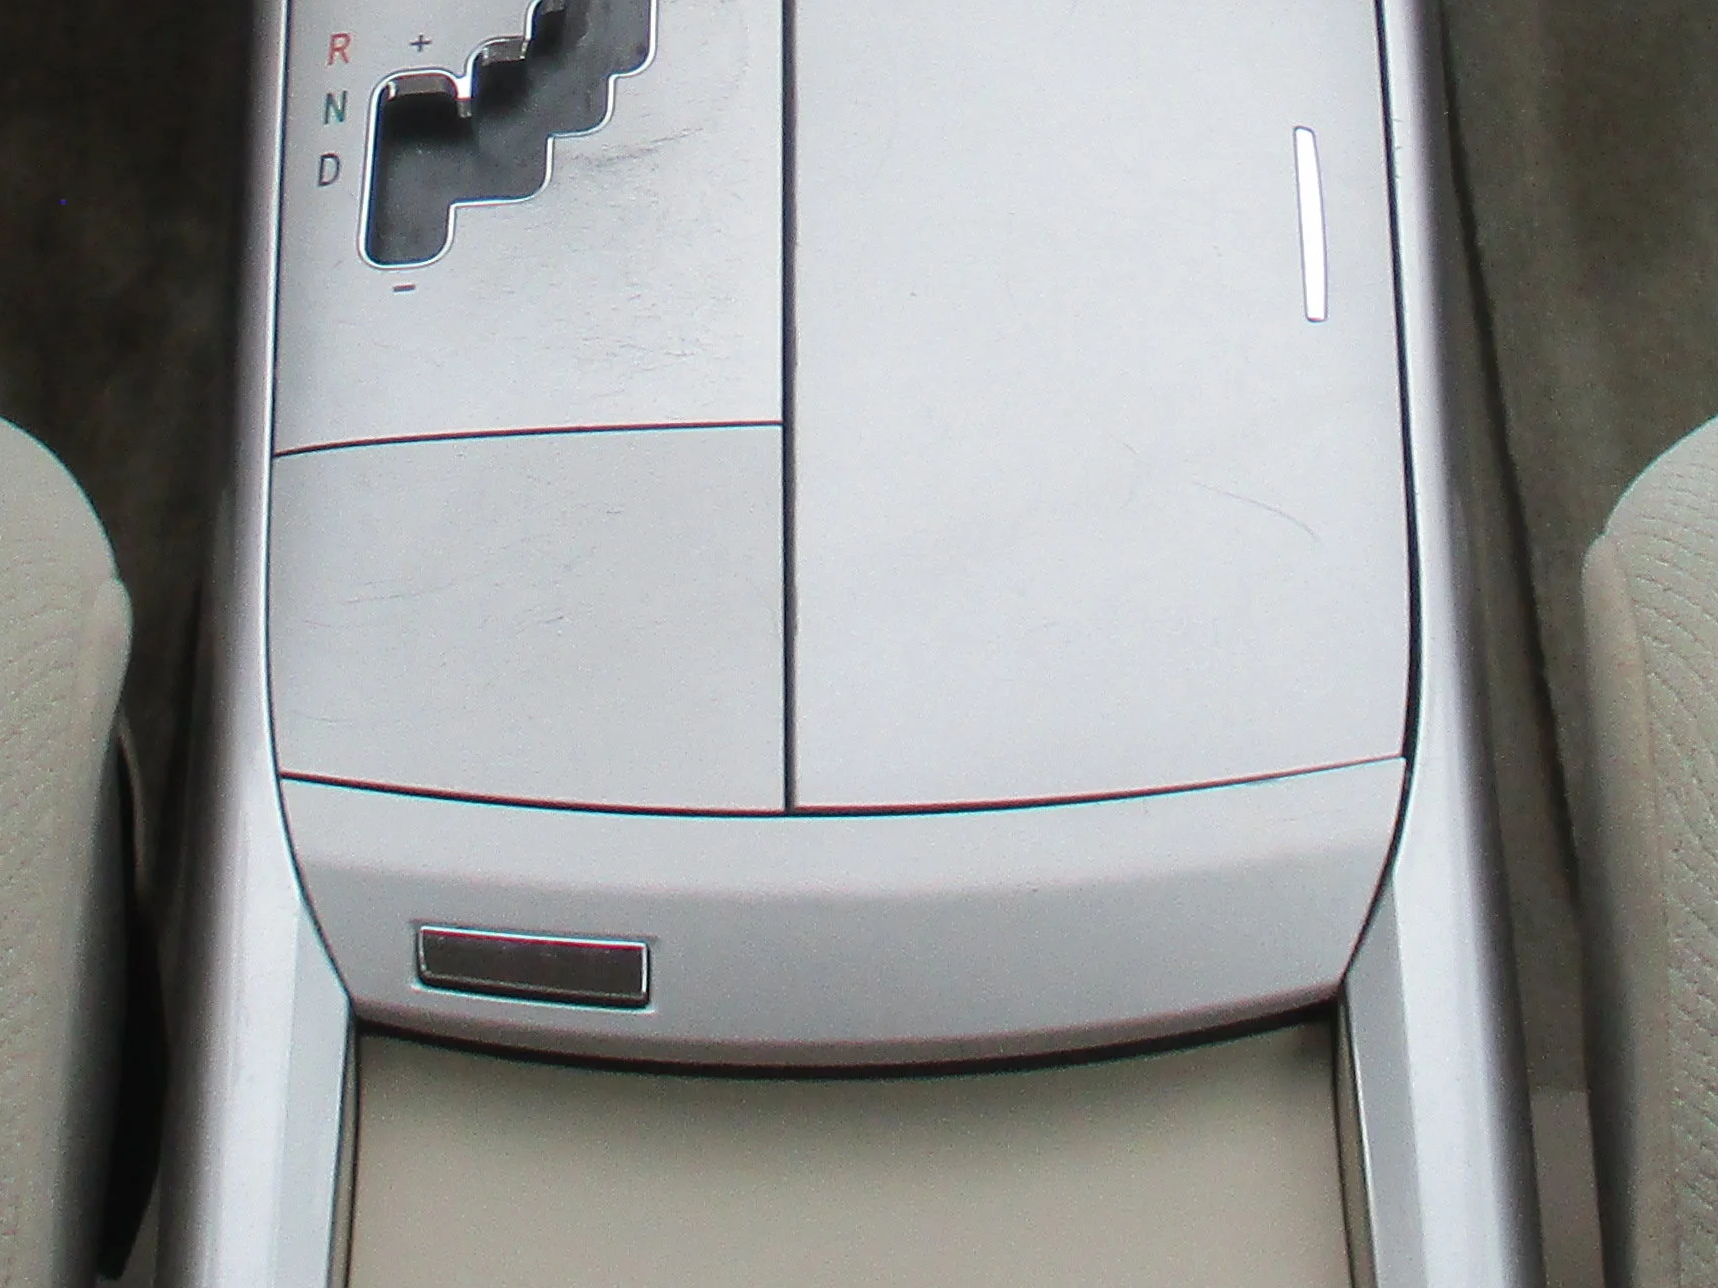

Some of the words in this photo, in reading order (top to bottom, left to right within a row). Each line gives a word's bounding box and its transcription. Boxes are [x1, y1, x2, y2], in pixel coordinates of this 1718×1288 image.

[327, 32, 352, 66] R
[322, 90, 347, 125] N
[316, 152, 341, 188] D
